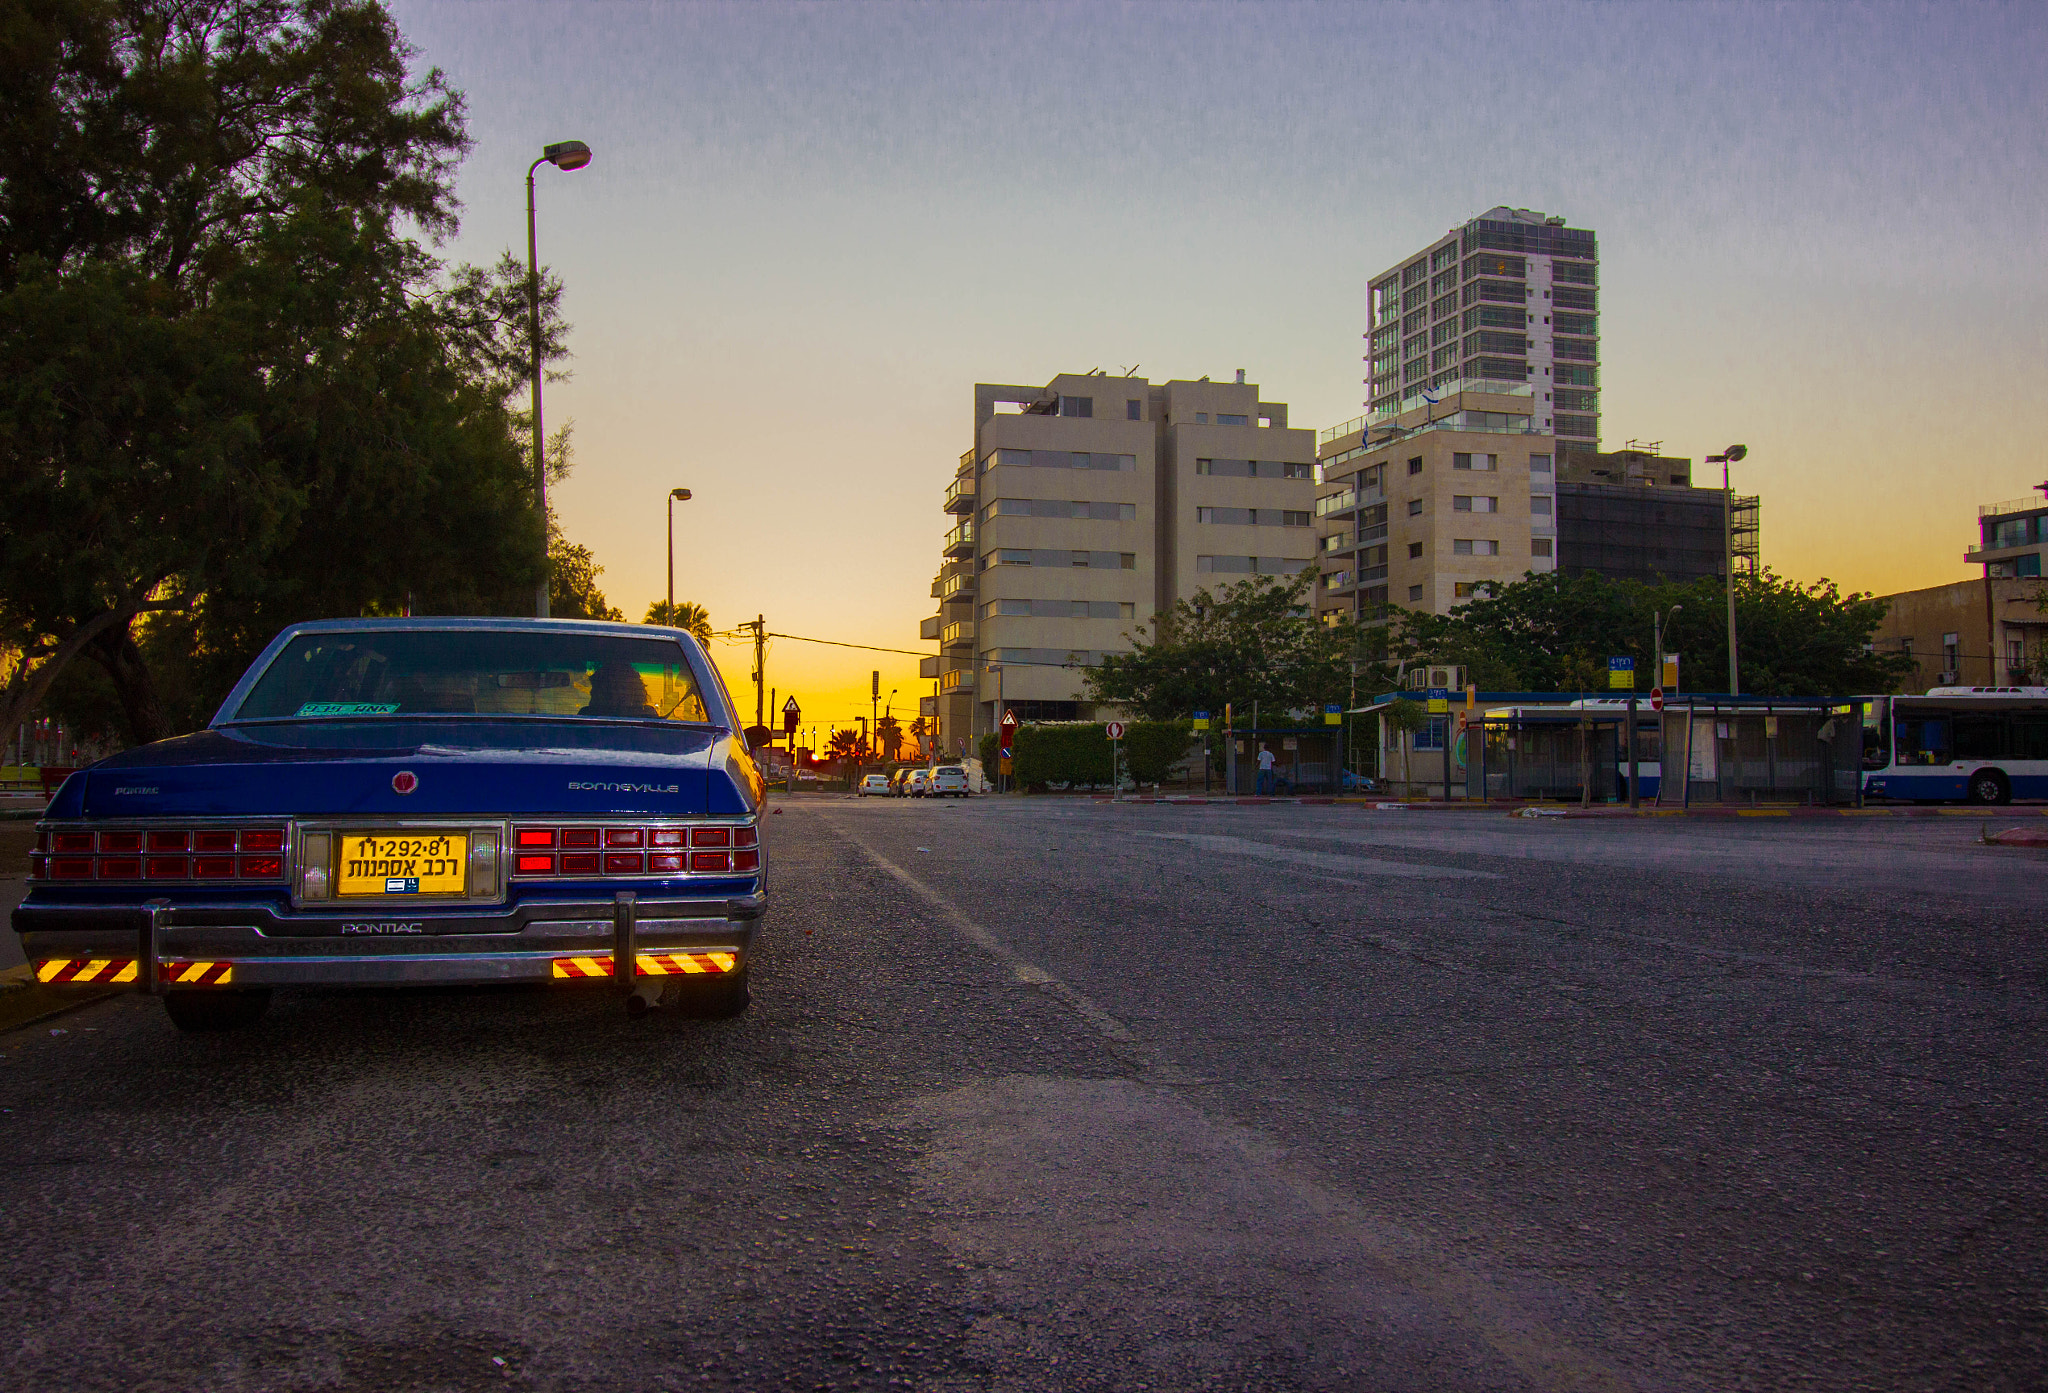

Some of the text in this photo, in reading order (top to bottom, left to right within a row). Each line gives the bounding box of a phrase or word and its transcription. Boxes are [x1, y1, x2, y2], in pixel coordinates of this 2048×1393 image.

[114, 786, 160, 796] PONTIAC
[567, 781, 680, 793] BONNEVILLE
[347, 858, 459, 878] רכב אספנות
[341, 922, 423, 934] PONTIAC
